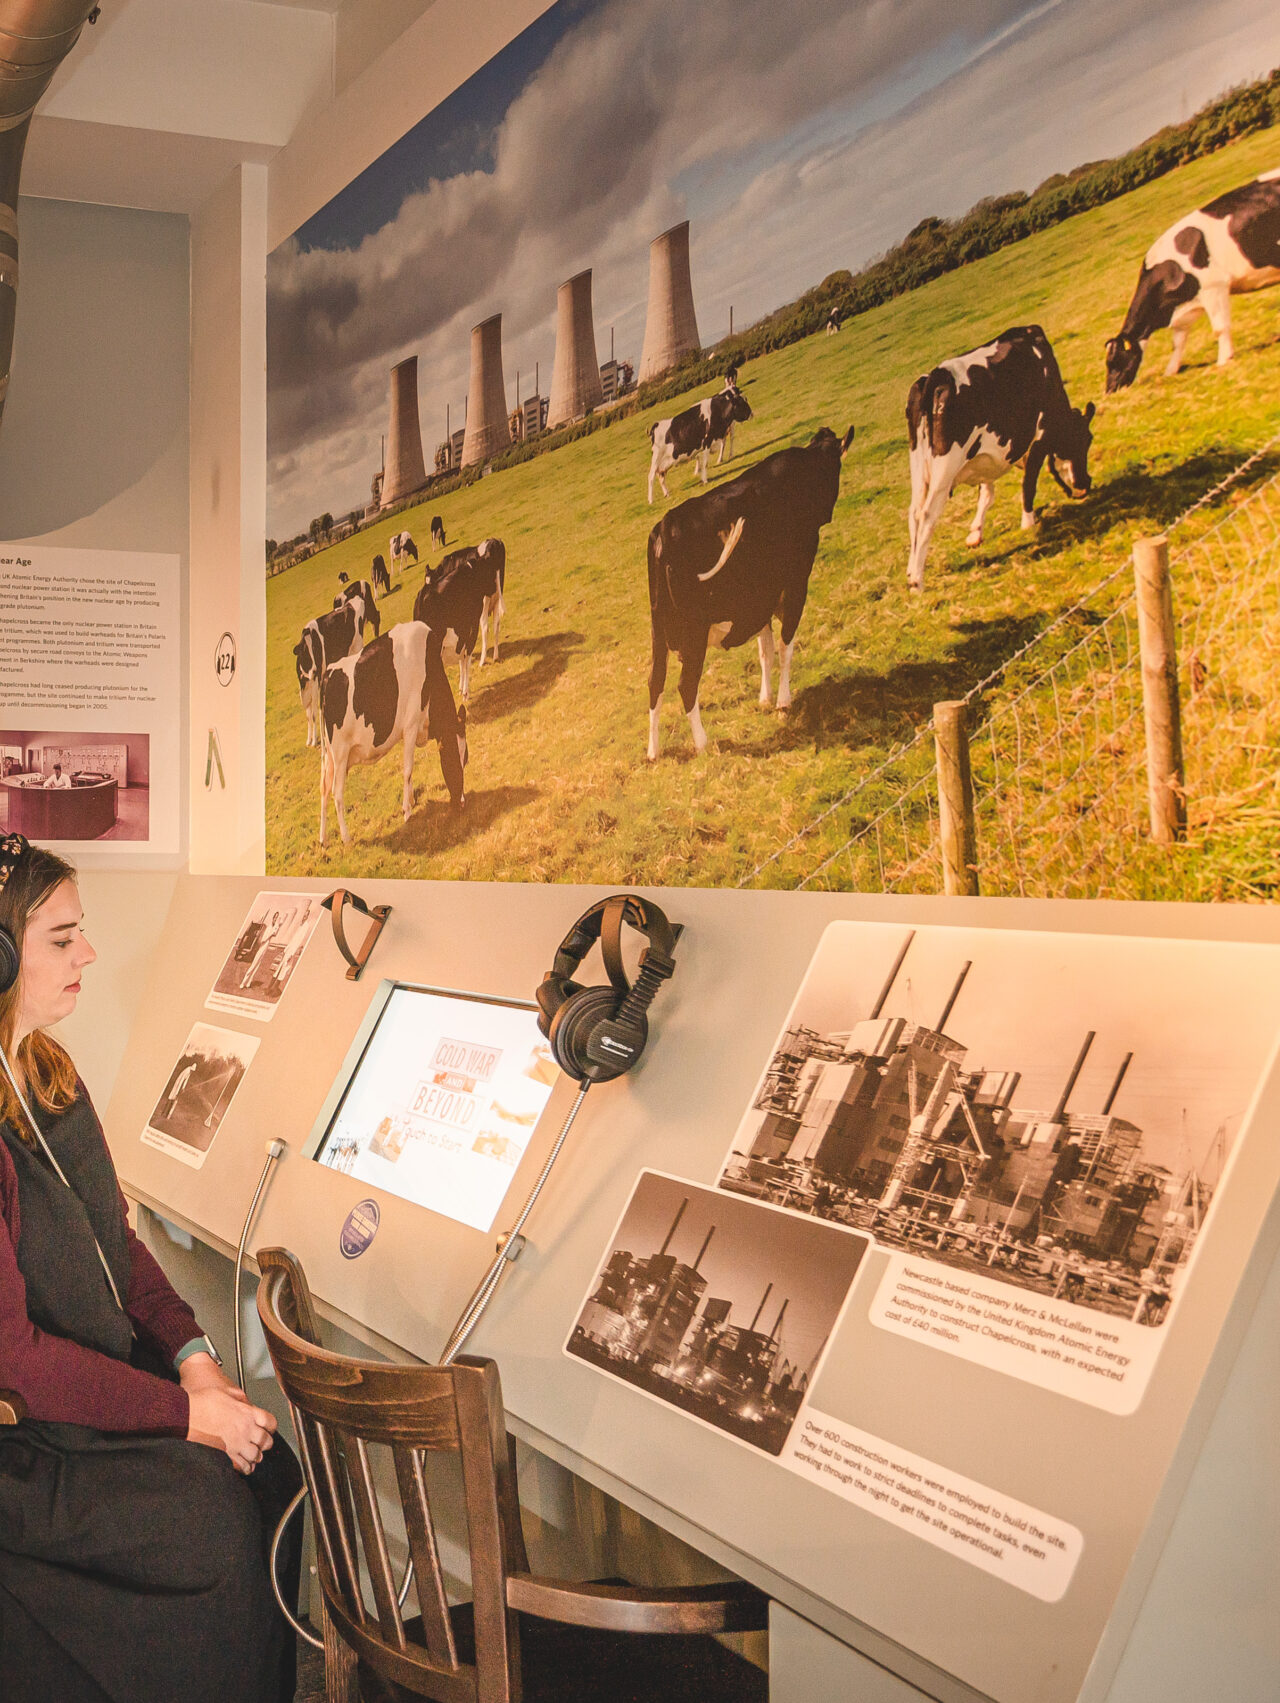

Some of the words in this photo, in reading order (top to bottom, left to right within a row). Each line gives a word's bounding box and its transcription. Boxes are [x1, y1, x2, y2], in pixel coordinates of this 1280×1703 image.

[14, 556, 32, 567] Age
[220, 652, 231, 670] 22
[435, 1043, 467, 1069] COLD
[465, 1048, 496, 1078] WAR
[444, 1076, 464, 1089] AND
[412, 1085, 476, 1125] BEYOND
[902, 1267, 943, 1287] Newcastle
[944, 1280, 970, 1295] based
[970, 1290, 1011, 1309] company
[1011, 1301, 1037, 1317] Merz
[1037, 1309, 1046, 1320] &
[1047, 1312, 1092, 1334] McLellan
[1094, 1330, 1119, 1343] were
[884, 1310, 902, 1321] cost
[902, 1316, 912, 1324] of
[911, 1318, 930, 1331] £40
[929, 1326, 959, 1342] million.
[890, 1295, 928, 1315] Authority
[929, 1308, 938, 1318] to
[938, 1313, 980, 1332] construct
[980, 1325, 1037, 1352] Chapelcross,
[1040, 1348, 1061, 1359] with
[1062, 1355, 1075, 1364] an
[1076, 1360, 1125, 1381] expected
[895, 1282, 954, 1307] commissioned
[954, 1300, 966, 1311] by
[966, 1304, 981, 1316] the
[982, 1309, 1013, 1326] United
[1014, 1319, 1056, 1340] Kingdom
[1057, 1334, 1093, 1353] Atomic
[1094, 1345, 1130, 1366] Energy
